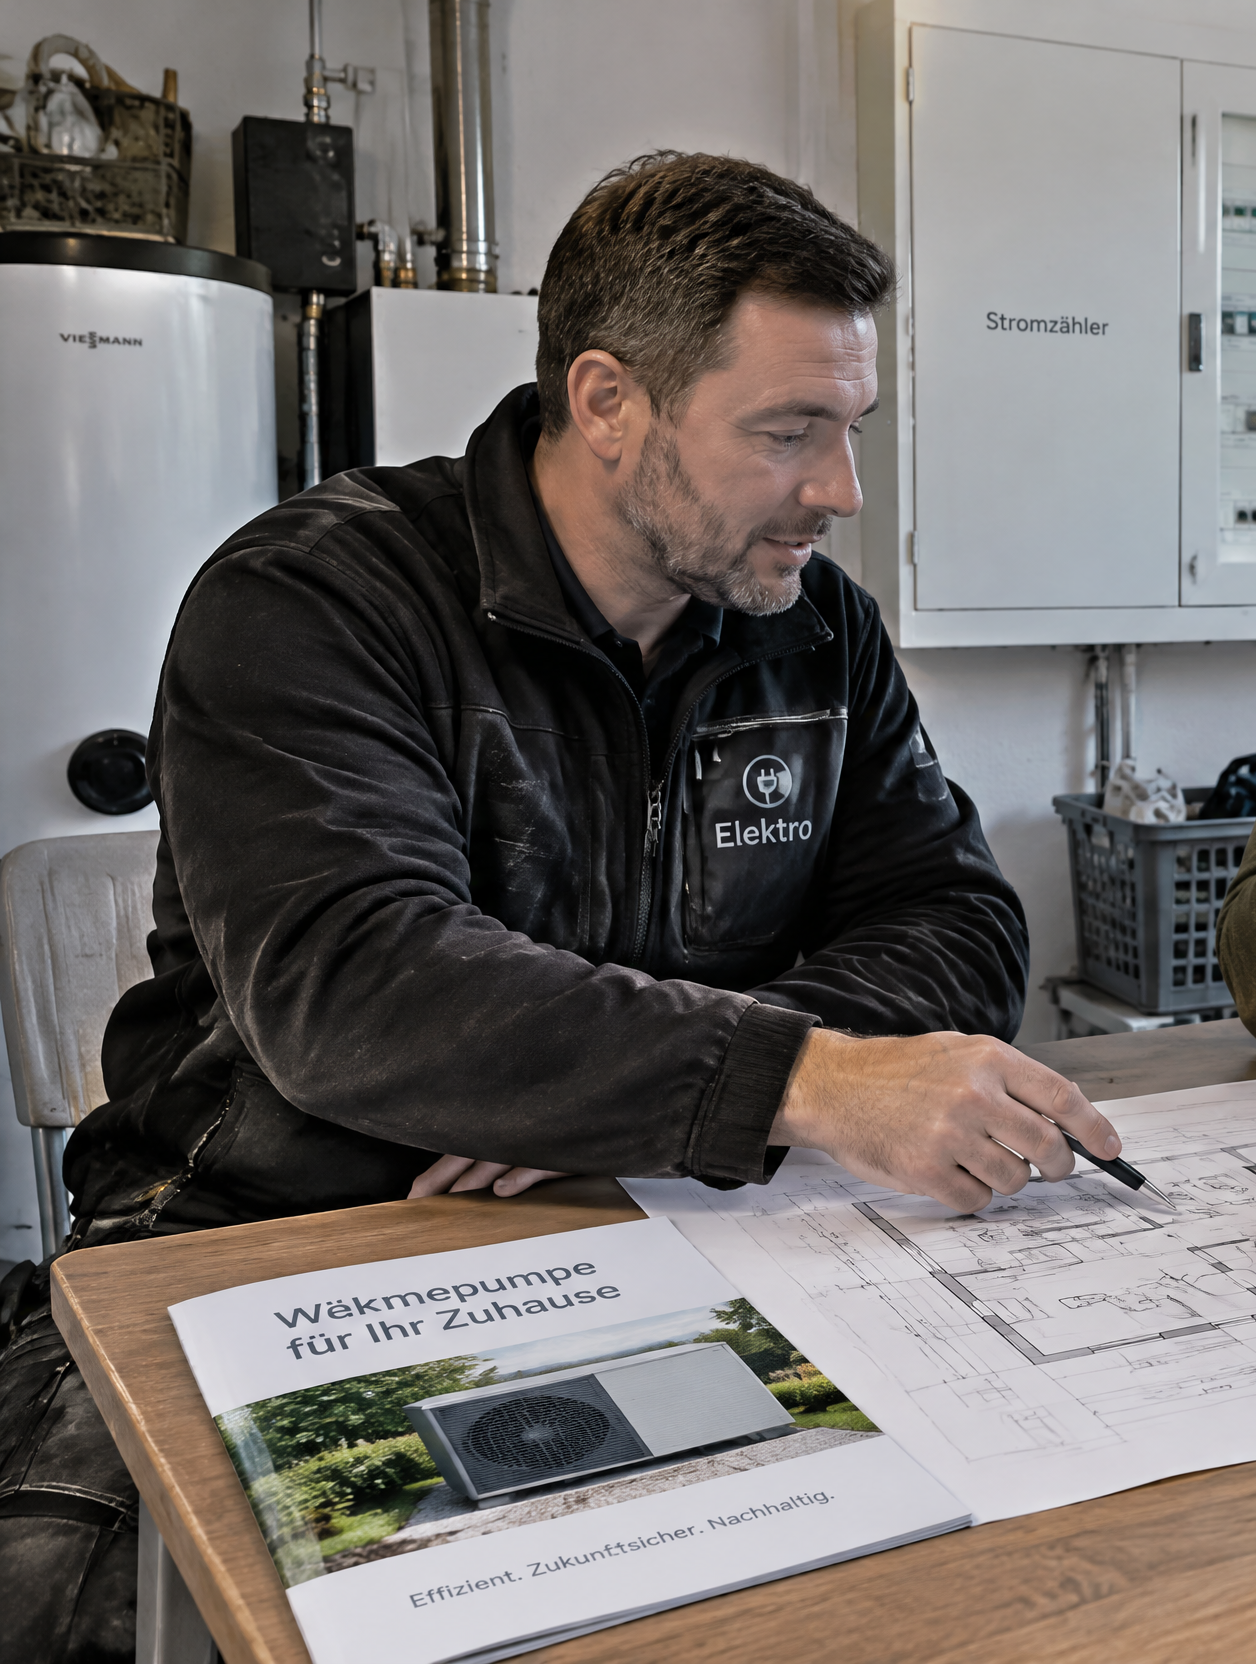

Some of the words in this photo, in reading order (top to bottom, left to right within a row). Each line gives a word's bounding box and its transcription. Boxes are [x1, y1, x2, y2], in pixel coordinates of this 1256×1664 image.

[986, 311, 1109, 336] Stromzähler
[715, 818, 813, 848] Elektro
[287, 1333, 352, 1360] für
[366, 1318, 425, 1343] Ihr
[436, 1285, 621, 1331] Zuhause
[409, 1568, 523, 1609] Effizient.
[708, 1490, 835, 1531] Nachhaltig.
